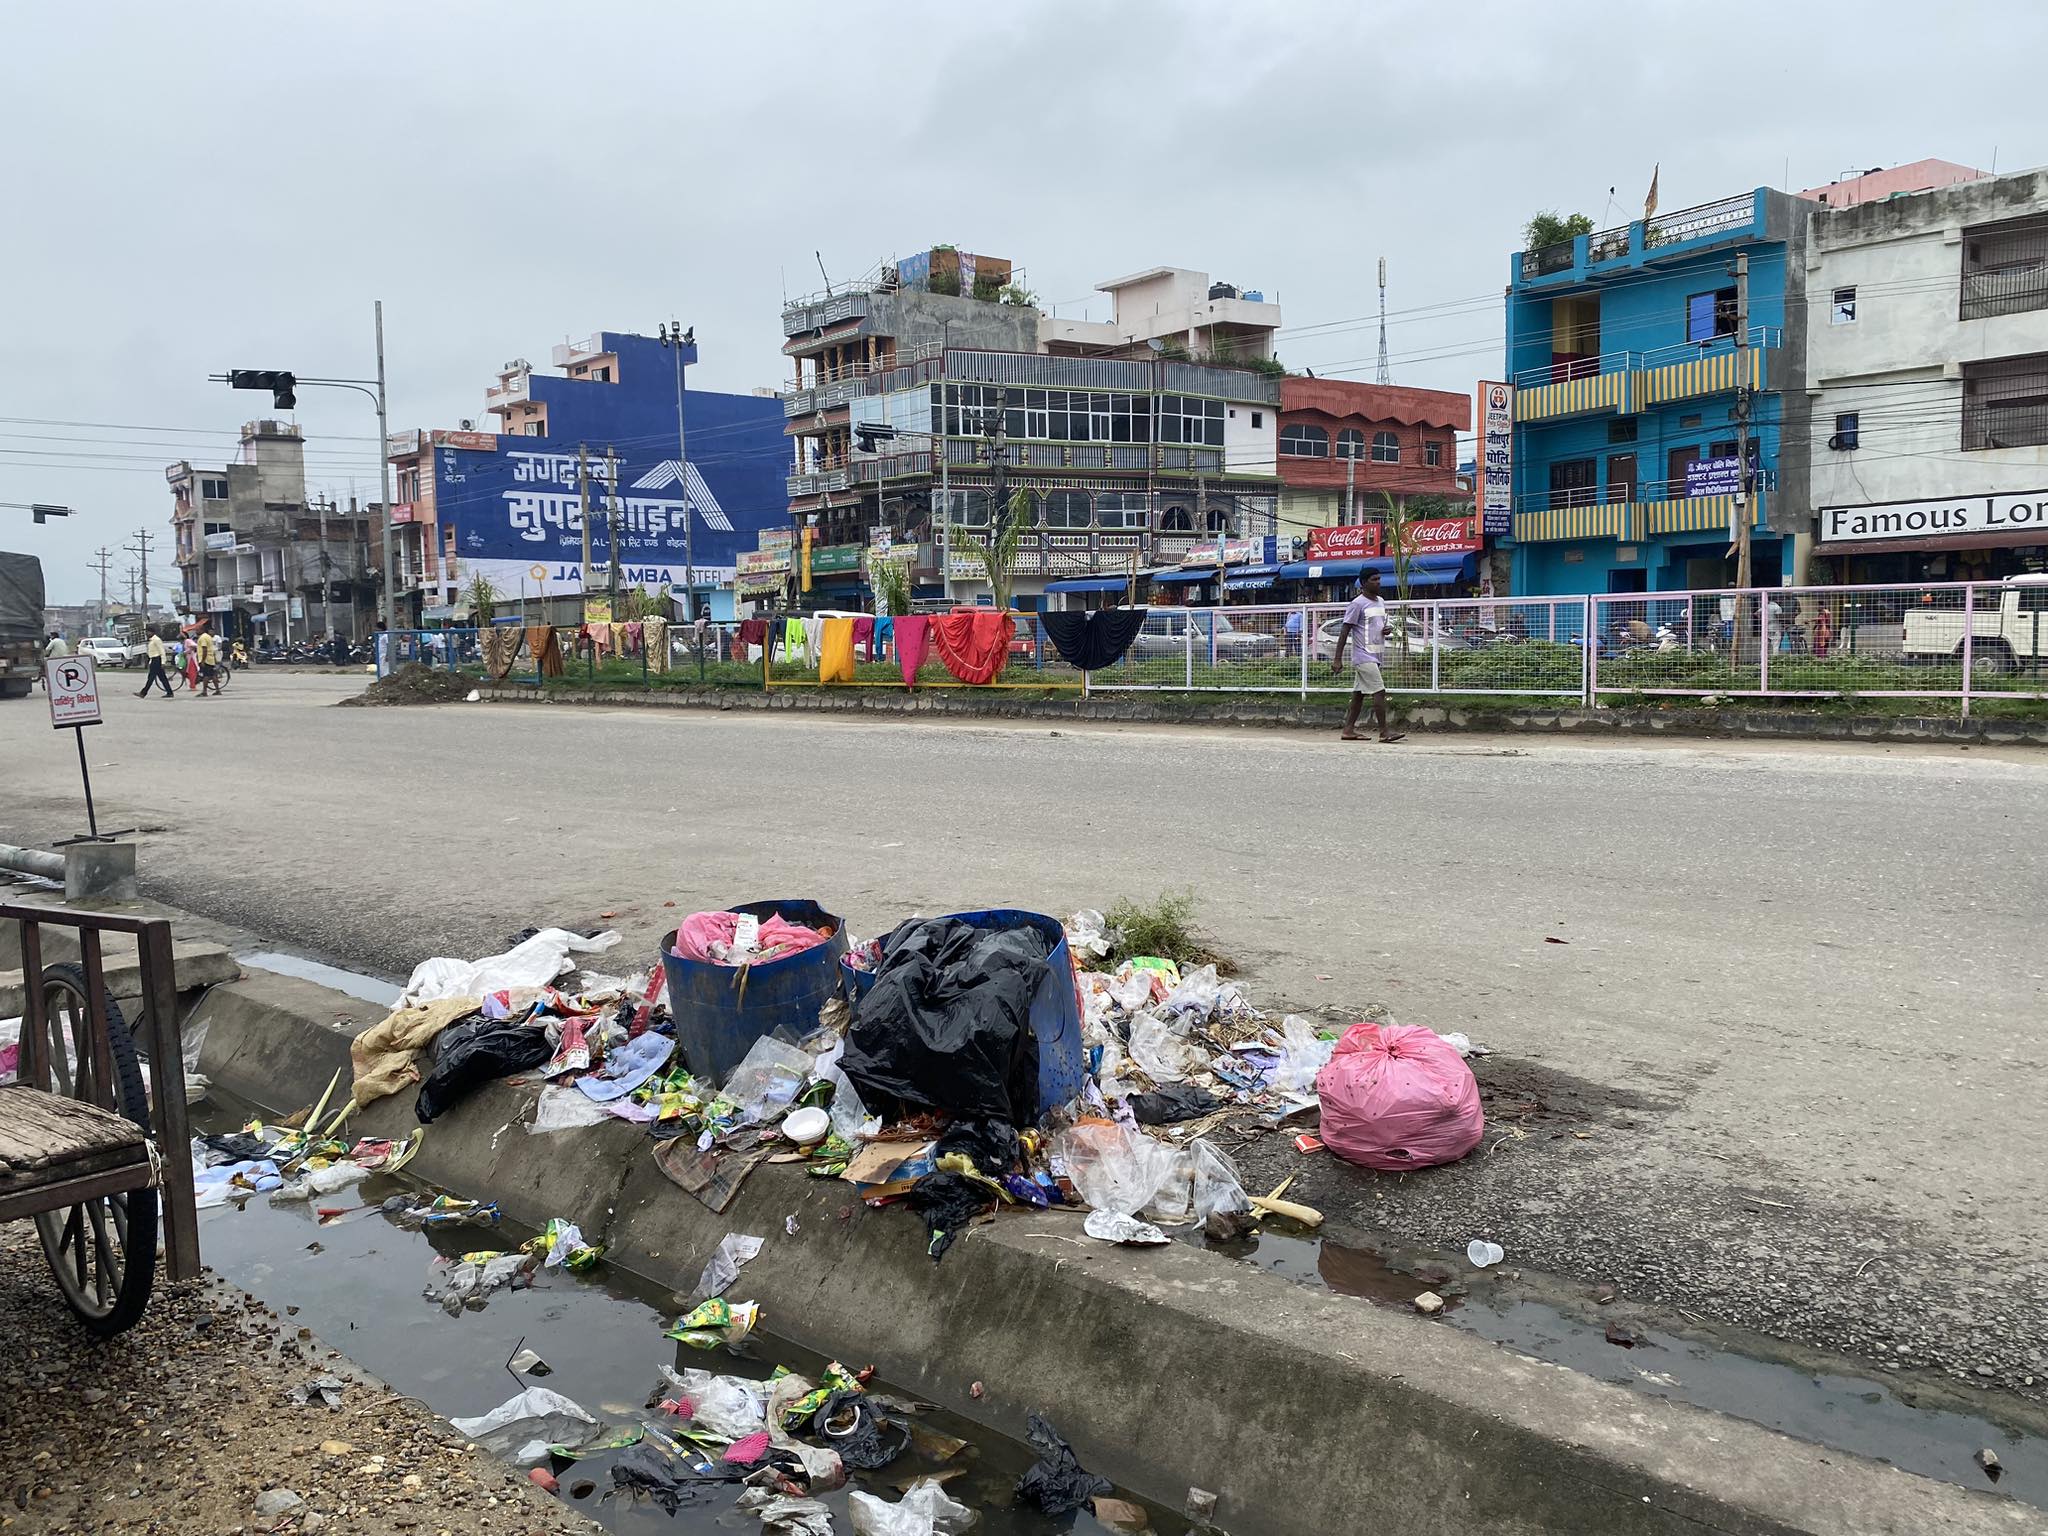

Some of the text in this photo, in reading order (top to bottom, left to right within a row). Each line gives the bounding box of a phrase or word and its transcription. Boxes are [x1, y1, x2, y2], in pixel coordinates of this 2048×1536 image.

[1487, 431, 1509, 448] जीतपुर
[1486, 449, 1509, 464] पोलि
[1485, 466, 1510, 485] क्लिनिक
[1412, 521, 1465, 541] Coca-Cola
[1832, 508, 1967, 535] Famous
[1327, 528, 1366, 547] Coca-Cola
[552, 566, 672, 584] JAMBA
